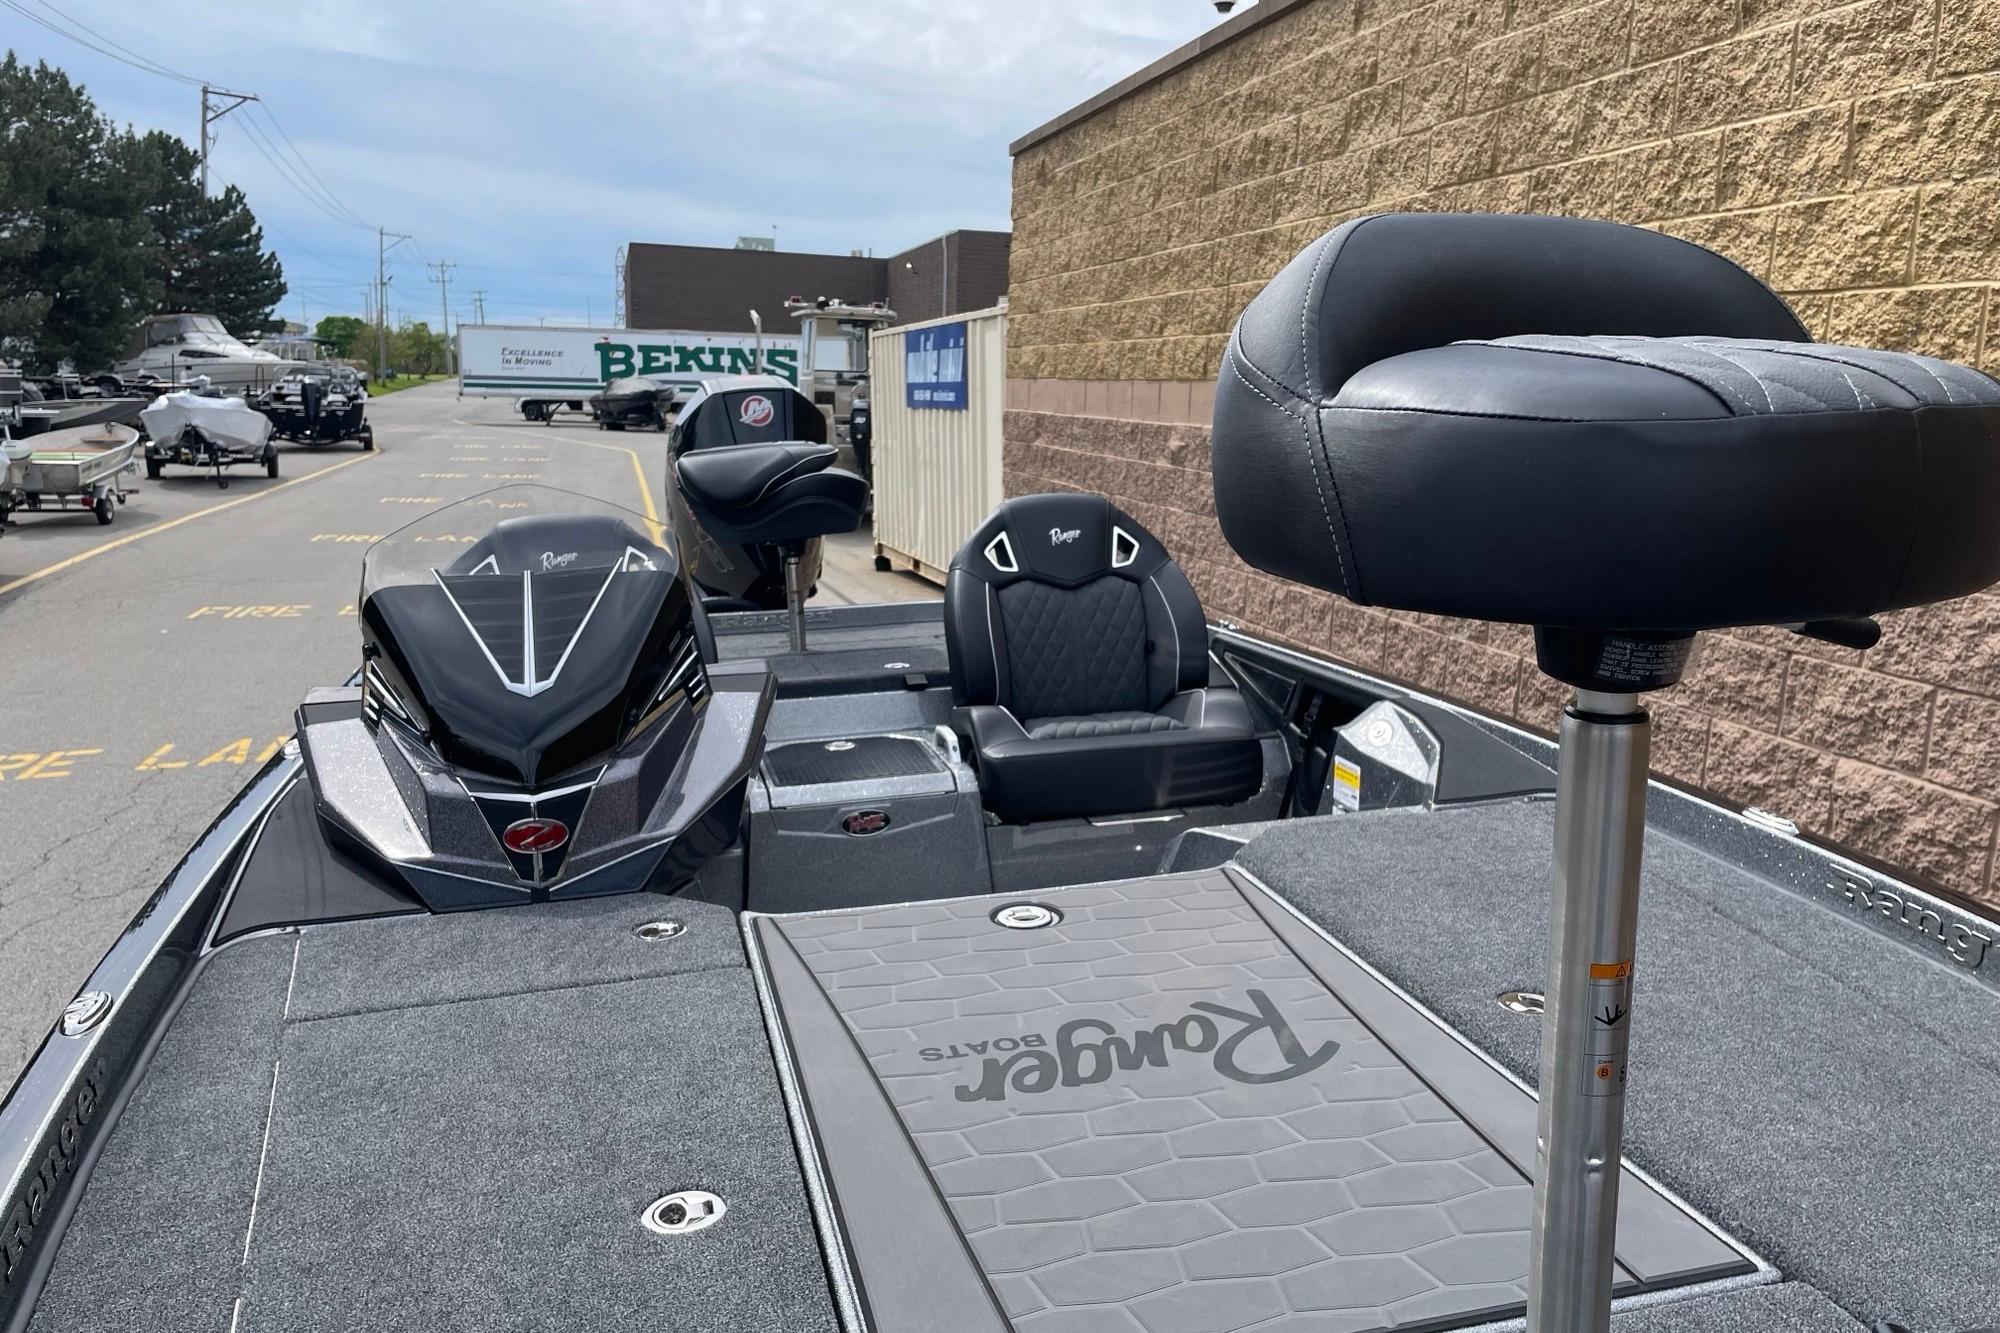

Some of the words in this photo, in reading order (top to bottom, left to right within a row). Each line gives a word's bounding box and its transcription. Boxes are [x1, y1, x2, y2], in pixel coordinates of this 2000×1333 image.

[595, 343, 798, 387] BEKINS
[1049, 527, 1082, 547] Ranger
[539, 551, 578, 572] Ranger
[187, 603, 313, 619] FIRE
[0, 748, 104, 781] RE
[1825, 862, 1998, 969] Rang
[918, 1032, 1049, 1063] BOATS
[954, 988, 1341, 1102] Ranger
